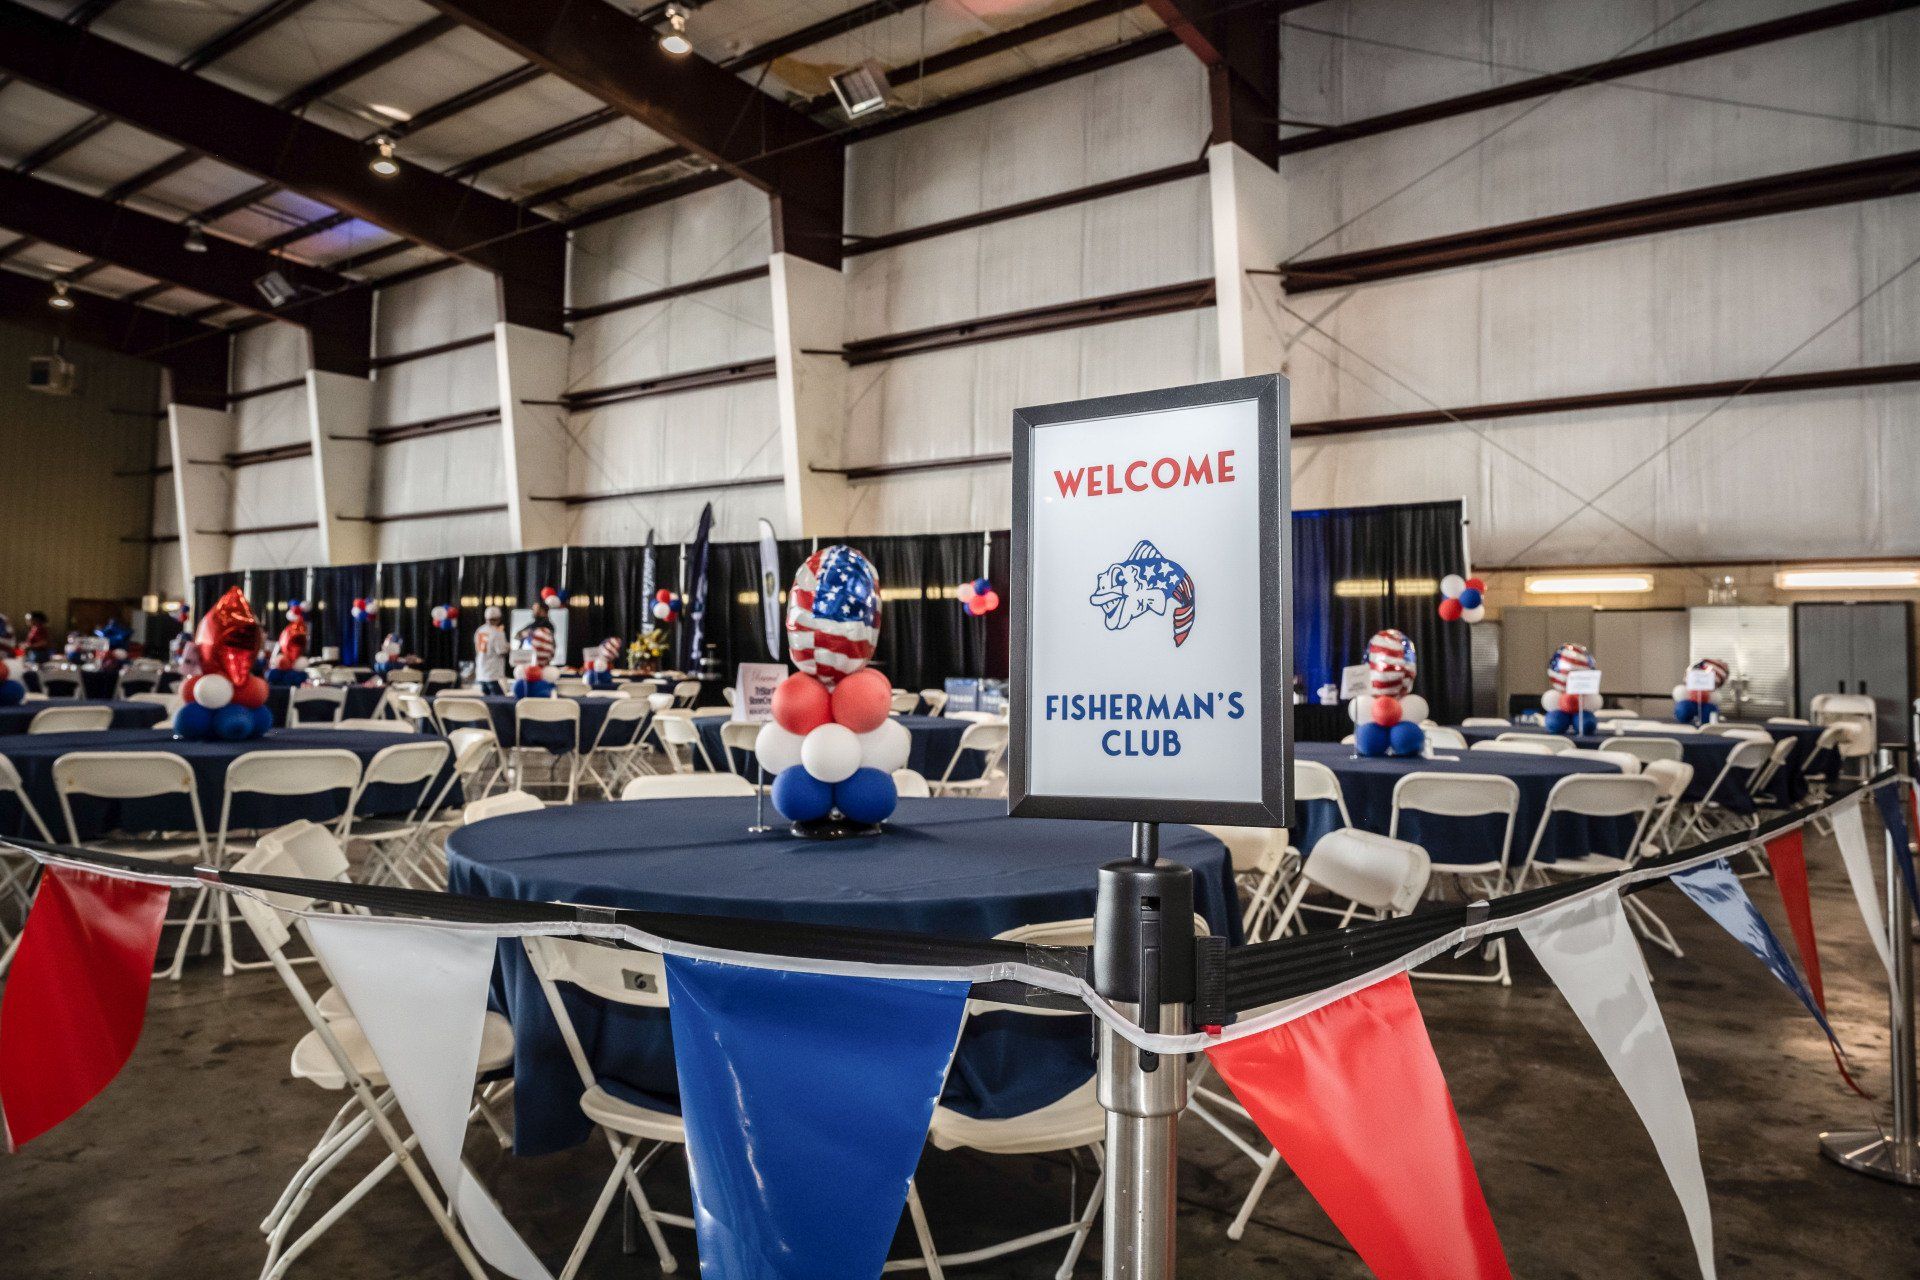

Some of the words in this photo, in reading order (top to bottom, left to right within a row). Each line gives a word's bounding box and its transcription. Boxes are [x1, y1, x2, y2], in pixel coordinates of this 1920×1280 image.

[1054, 449, 1236, 498] WELCOME
[1045, 690, 1246, 721] FISHERMAN'S
[1101, 729, 1182, 757] CLUB
